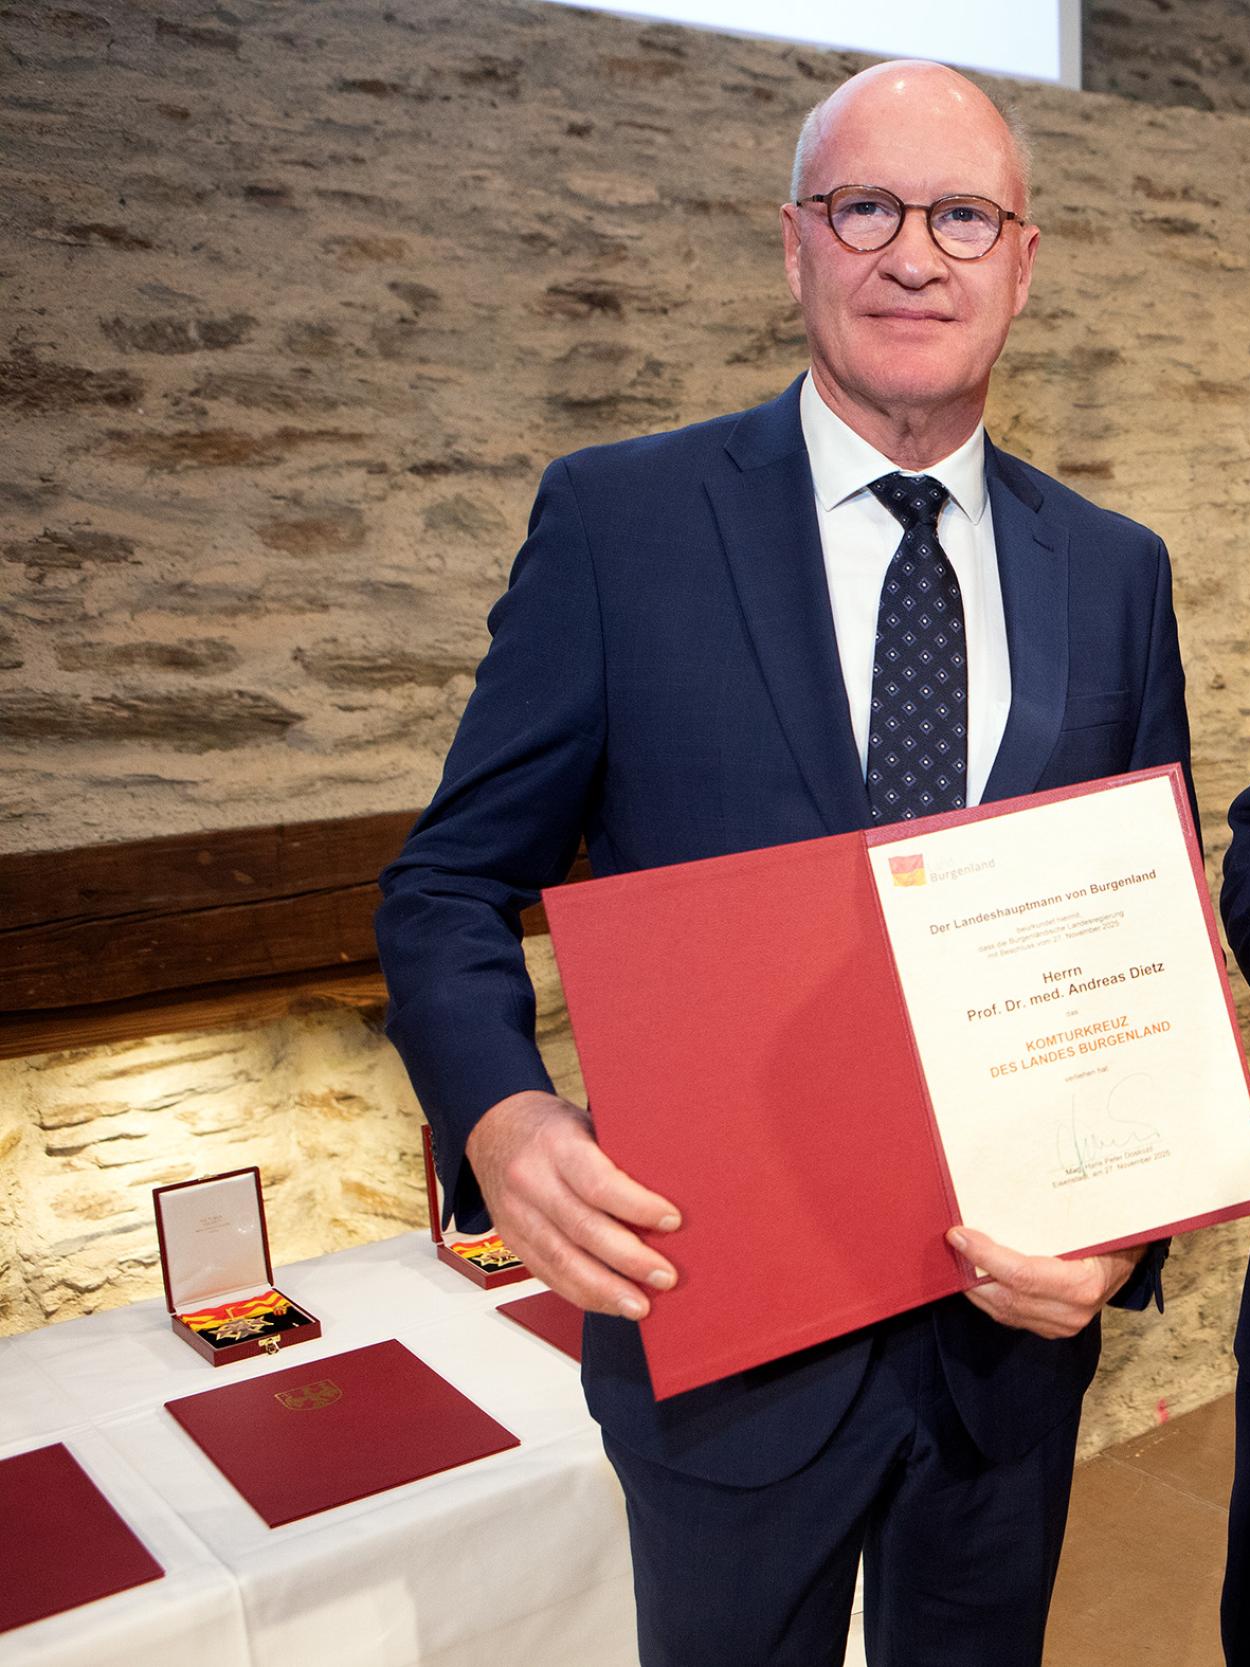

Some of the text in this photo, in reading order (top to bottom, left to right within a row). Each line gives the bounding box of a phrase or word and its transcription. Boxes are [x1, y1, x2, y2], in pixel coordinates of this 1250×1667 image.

[930, 858, 996, 883] Burgenland
[929, 869, 1156, 935] Der Landeshauptmann von Burgenland
[967, 961, 1165, 1021] Prof. Dr. med. Andreas Dietz
[1043, 965, 1082, 983] Herrn
[990, 1021, 1171, 1078] DES LANDES BURGENLAND
[1026, 1016, 1129, 1052] KOMTURKREUZ
